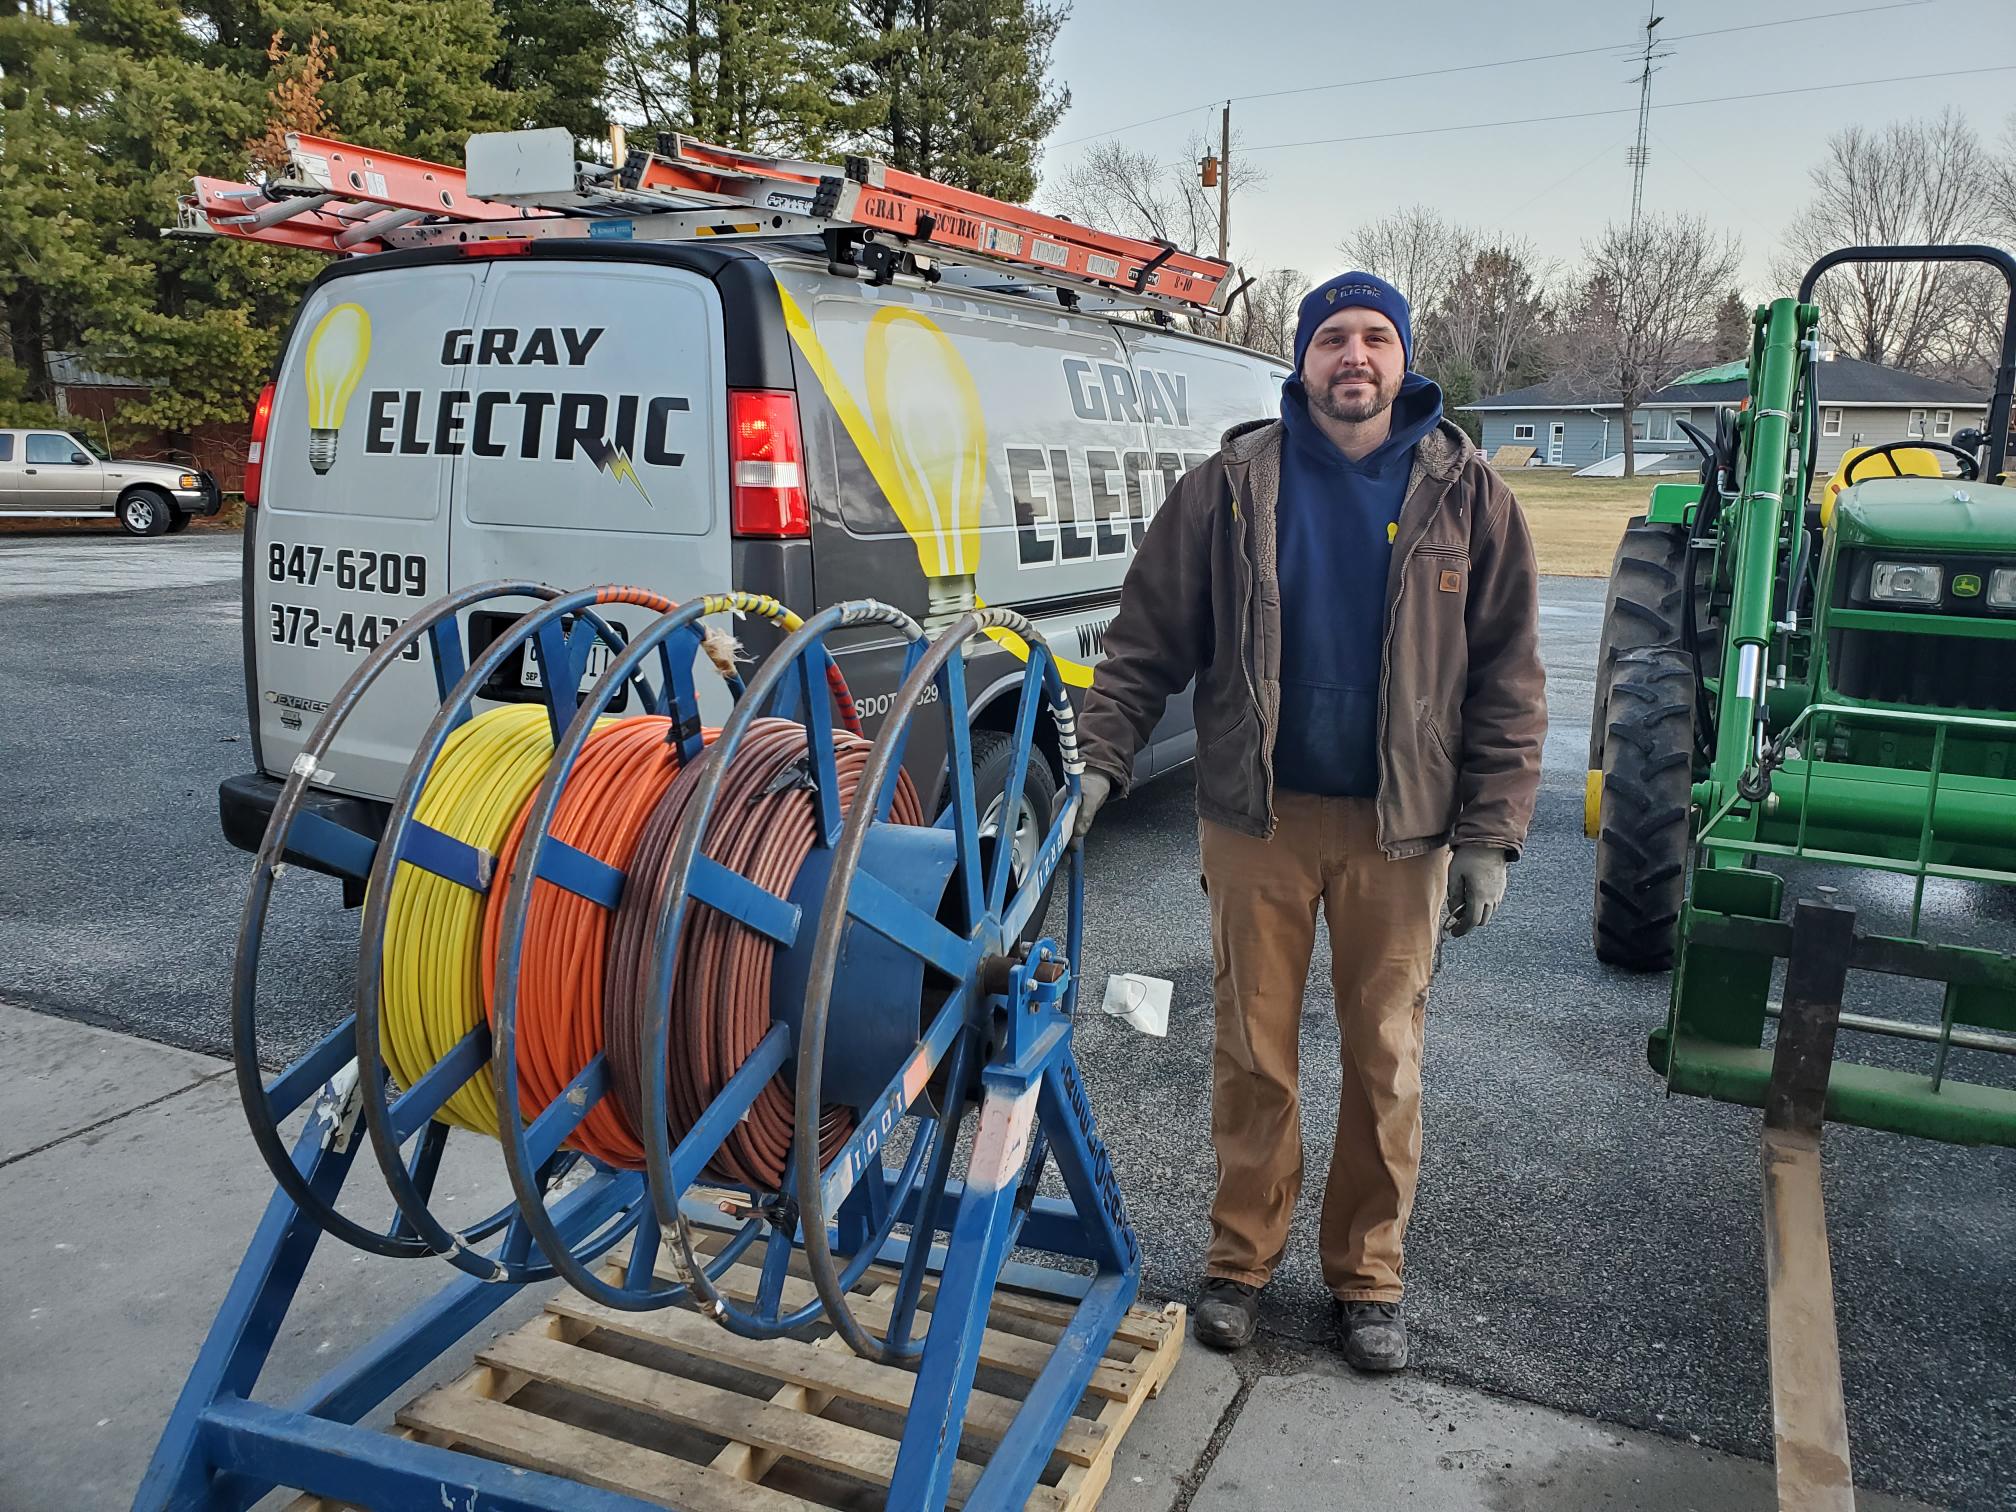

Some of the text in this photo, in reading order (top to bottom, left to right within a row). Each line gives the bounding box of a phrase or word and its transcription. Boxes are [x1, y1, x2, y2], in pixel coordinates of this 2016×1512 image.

[865, 197, 906, 222] GRAY
[1340, 288, 1381, 298] ELECTRIC
[440, 328, 606, 366] GRAY
[1060, 356, 1191, 430] GRAY
[364, 390, 692, 472] ELECTRIC
[267, 542, 428, 598] 847-6209
[525, 671, 539, 681] SEP
[280, 693, 329, 714] EXPRES
[855, 691, 898, 719] SDOT
